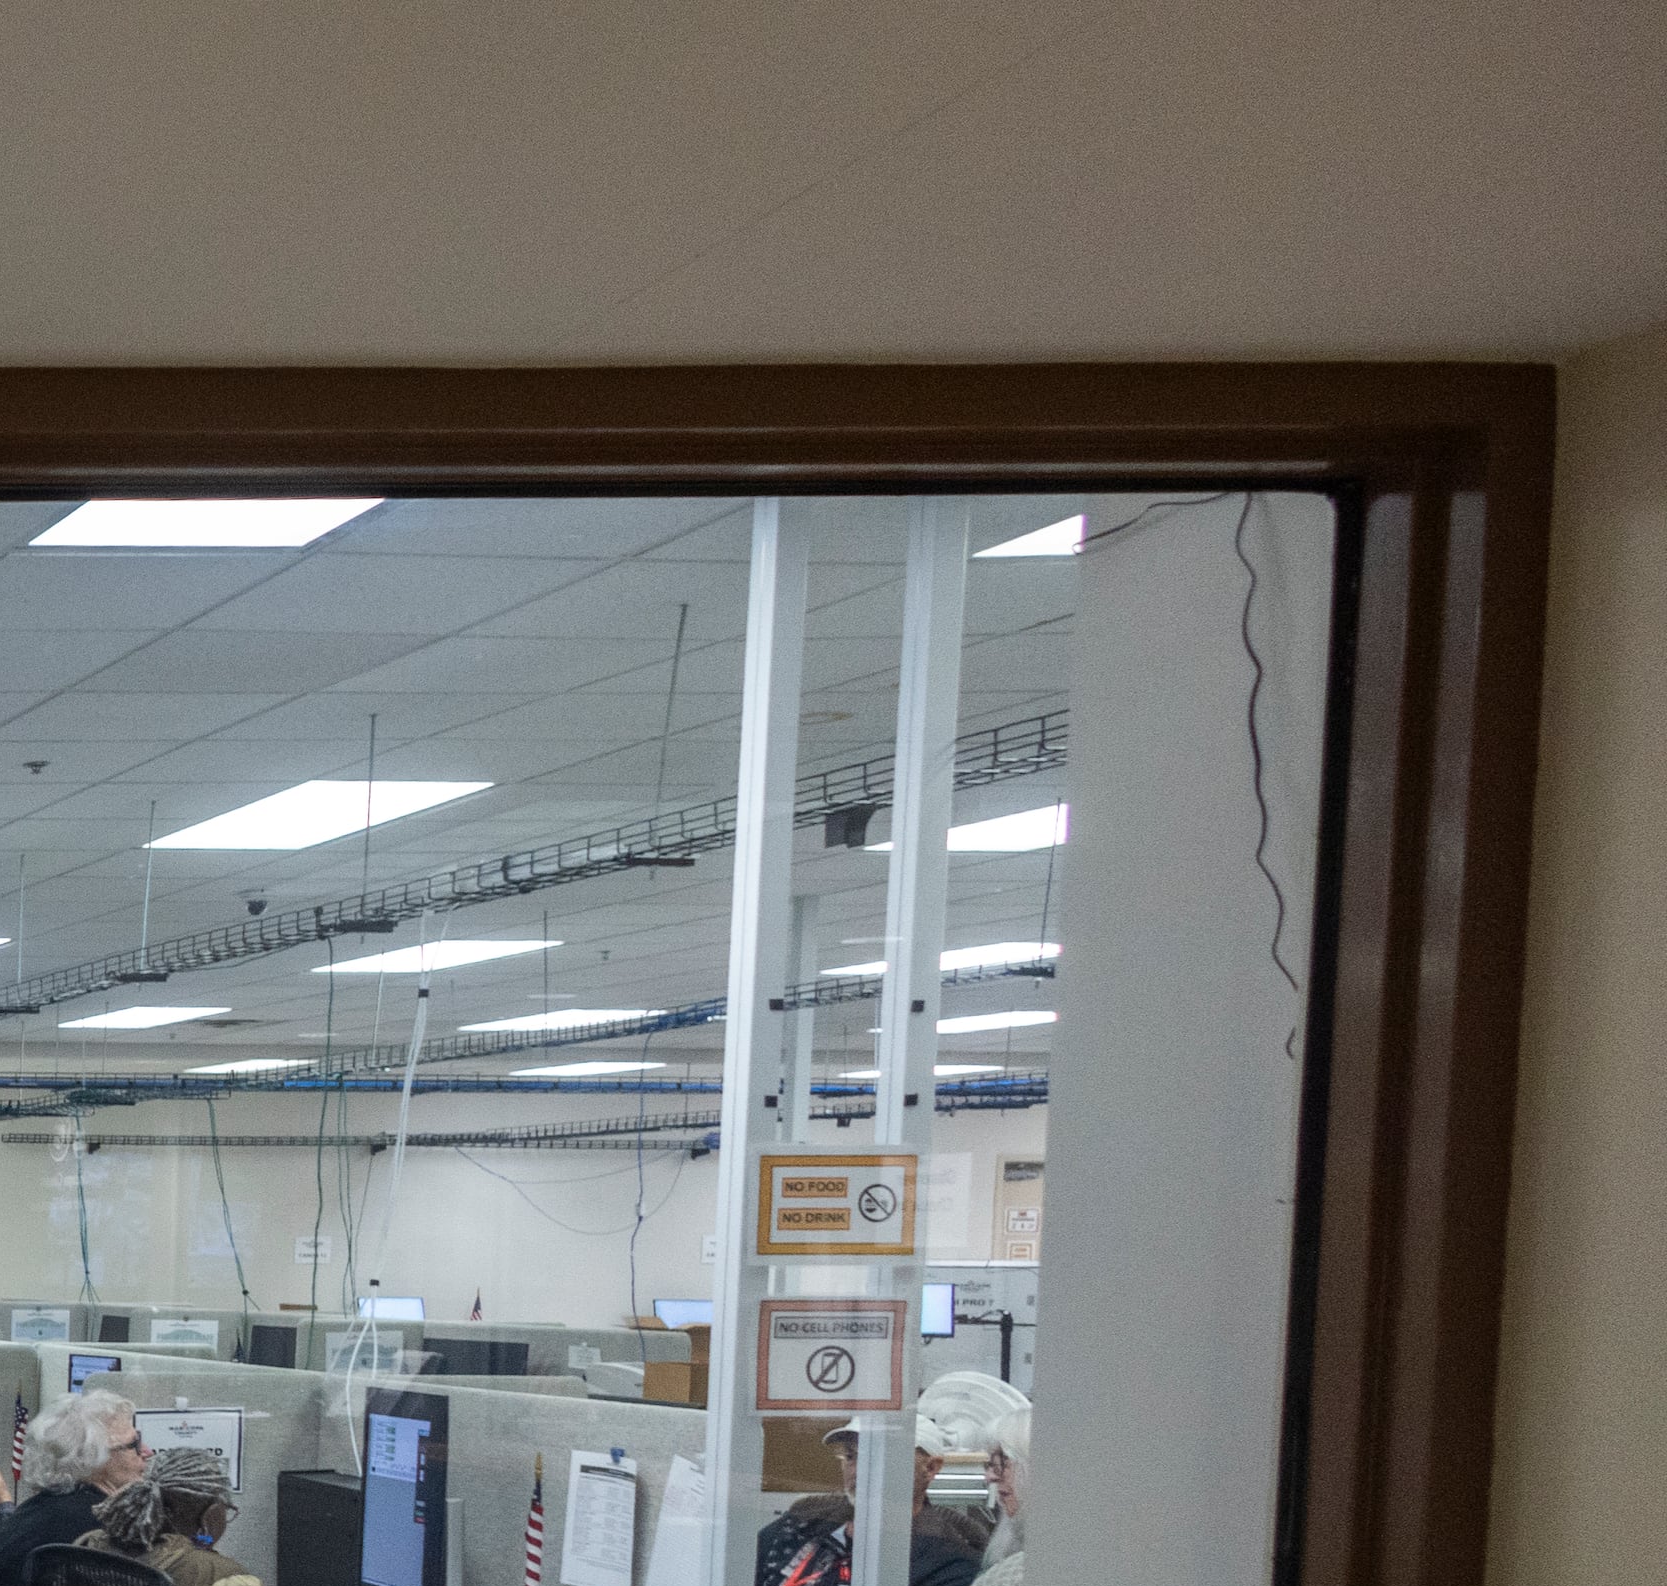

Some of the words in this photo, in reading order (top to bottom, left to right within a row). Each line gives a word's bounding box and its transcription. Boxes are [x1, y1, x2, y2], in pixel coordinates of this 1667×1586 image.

[785, 1181, 804, 1192] NO
[808, 1181, 845, 1192] FOOD
[782, 1213, 802, 1223] NO
[805, 1213, 846, 1223] DRINK
[779, 1323, 798, 1333] NO
[802, 1323, 830, 1333] CELL
[833, 1323, 884, 1334] PHONES
